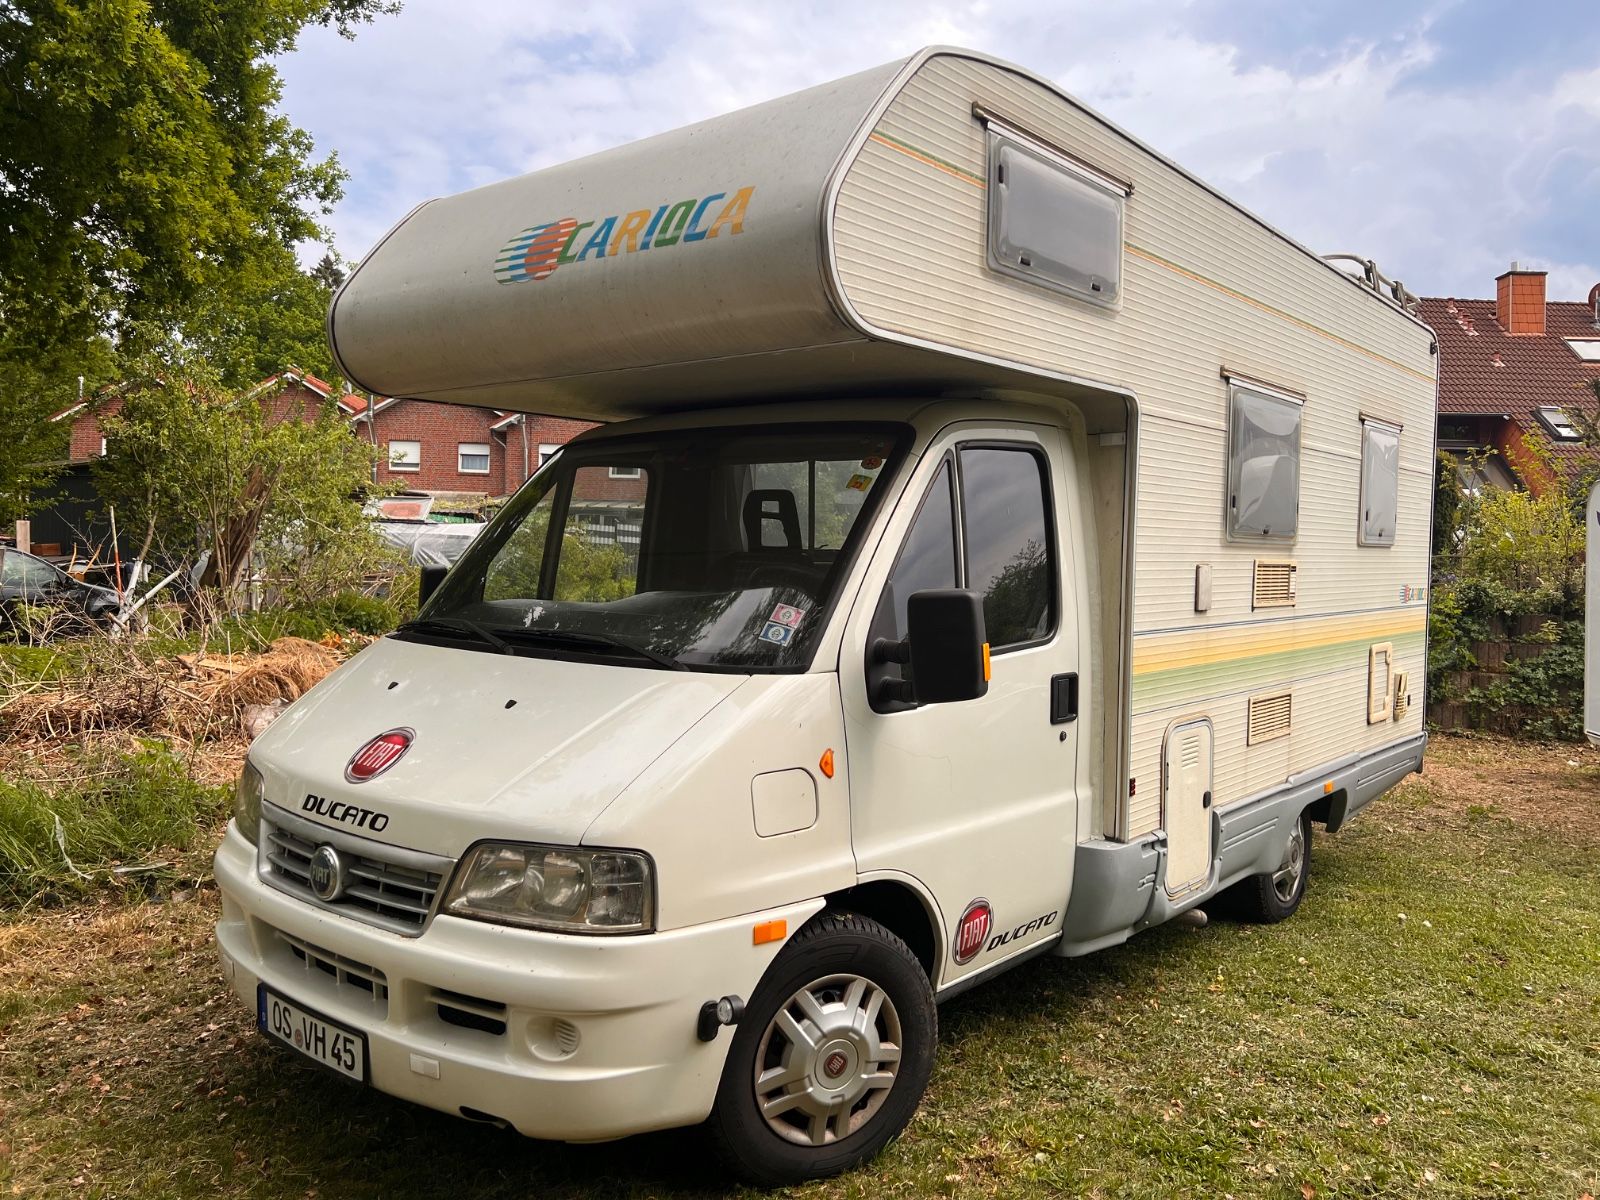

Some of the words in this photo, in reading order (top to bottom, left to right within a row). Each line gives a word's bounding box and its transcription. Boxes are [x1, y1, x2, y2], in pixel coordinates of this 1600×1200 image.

[556, 185, 756, 265] CARIOCA
[357, 741, 403, 769] FIAT
[302, 794, 389, 832] DUCATO
[312, 865, 330, 884] FIAT
[962, 914, 987, 951] FIAT
[986, 911, 1058, 952] DUCATO
[273, 1001, 292, 1039] OS
[303, 1017, 326, 1059] VH
[331, 1033, 355, 1071] 45
